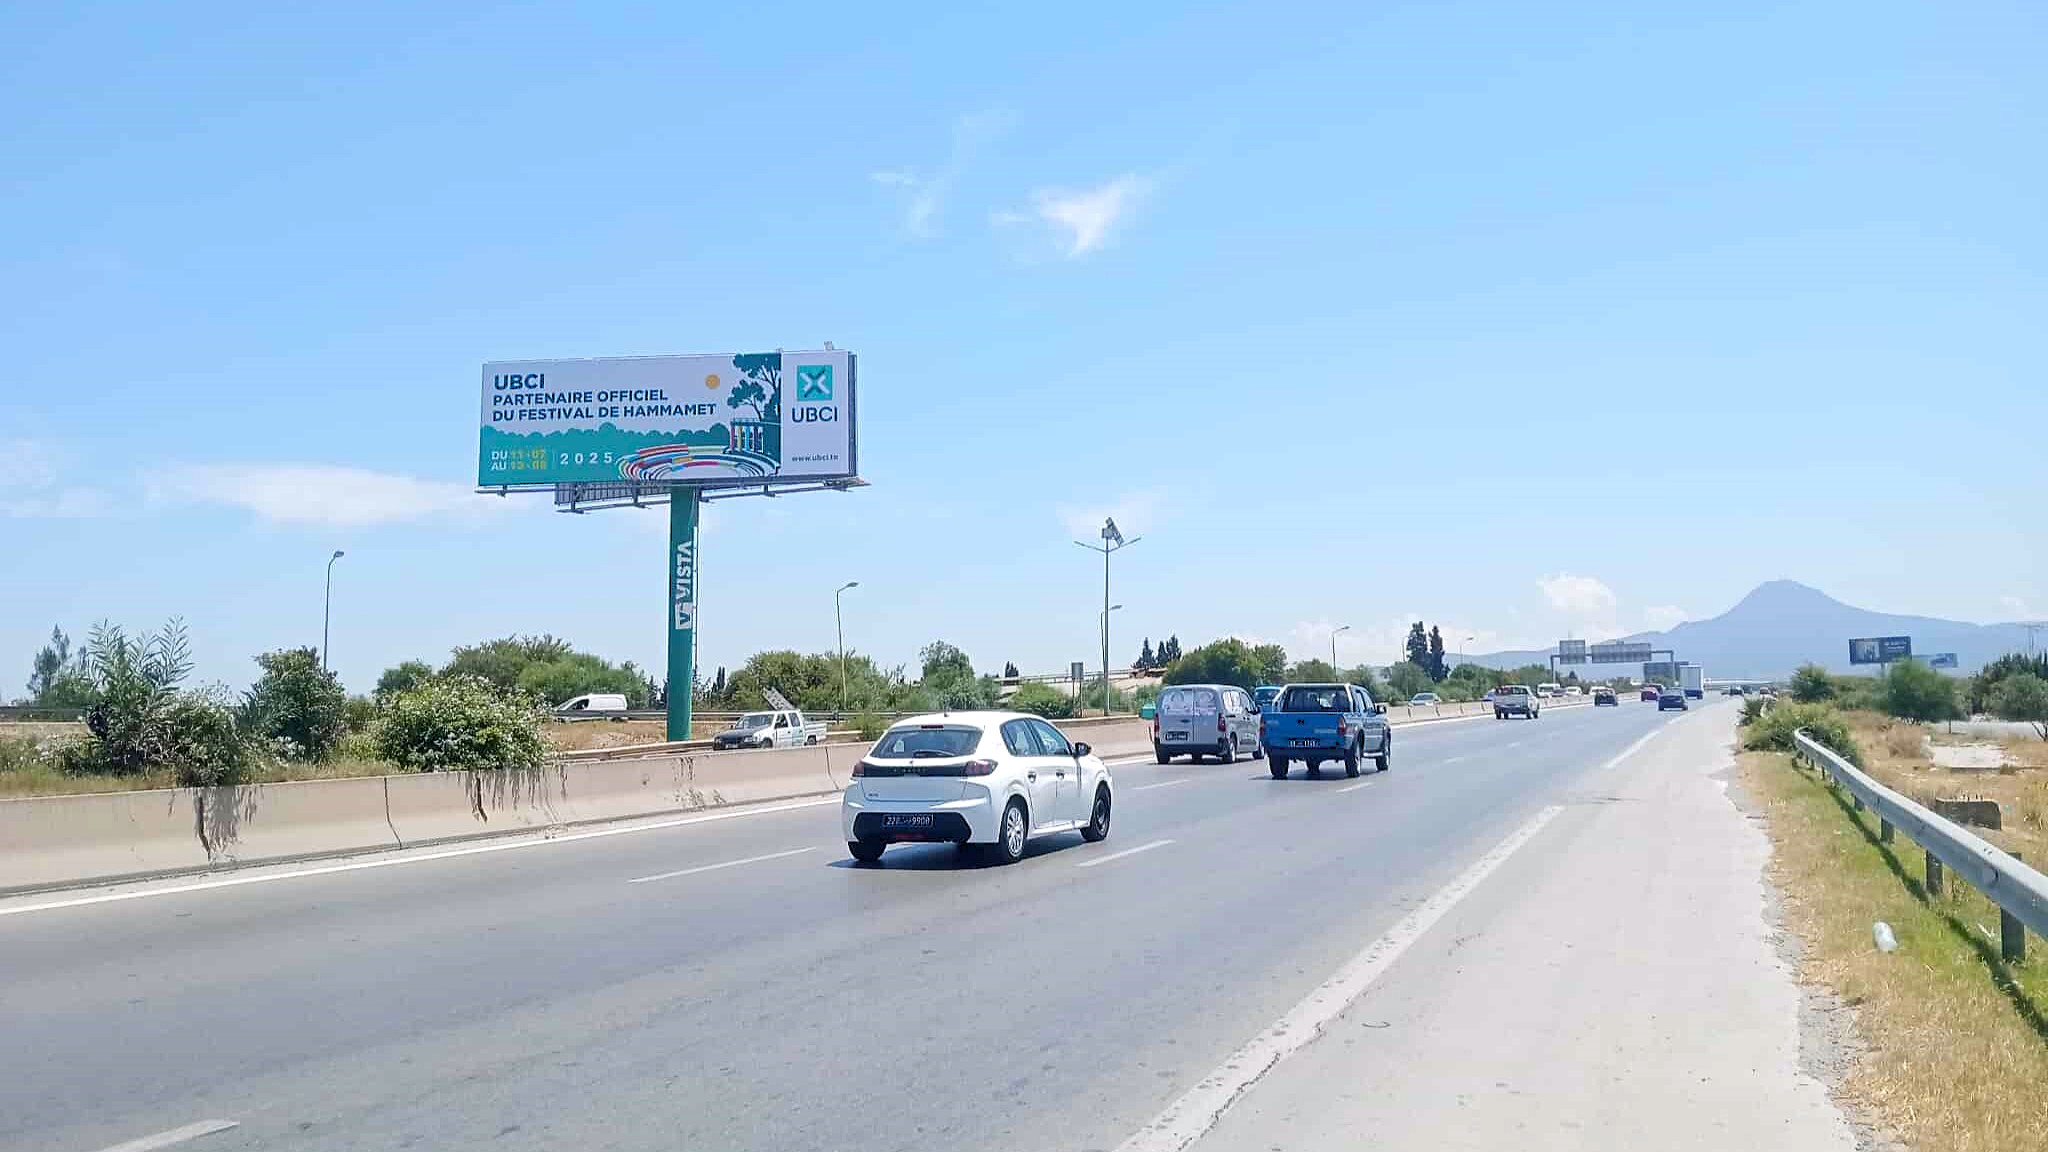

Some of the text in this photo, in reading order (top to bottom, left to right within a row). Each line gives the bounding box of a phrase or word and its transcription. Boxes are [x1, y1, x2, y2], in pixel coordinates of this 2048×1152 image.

[494, 373, 545, 390] UBCI
[493, 389, 669, 406] PARTENAIRE OFFICIEL
[493, 403, 717, 422] DU FESTIVAL DE HAMMAMET
[791, 405, 838, 423] UBCI
[491, 450, 508, 460] DU
[490, 460, 507, 471] AU
[676, 540, 692, 601] VISTA
